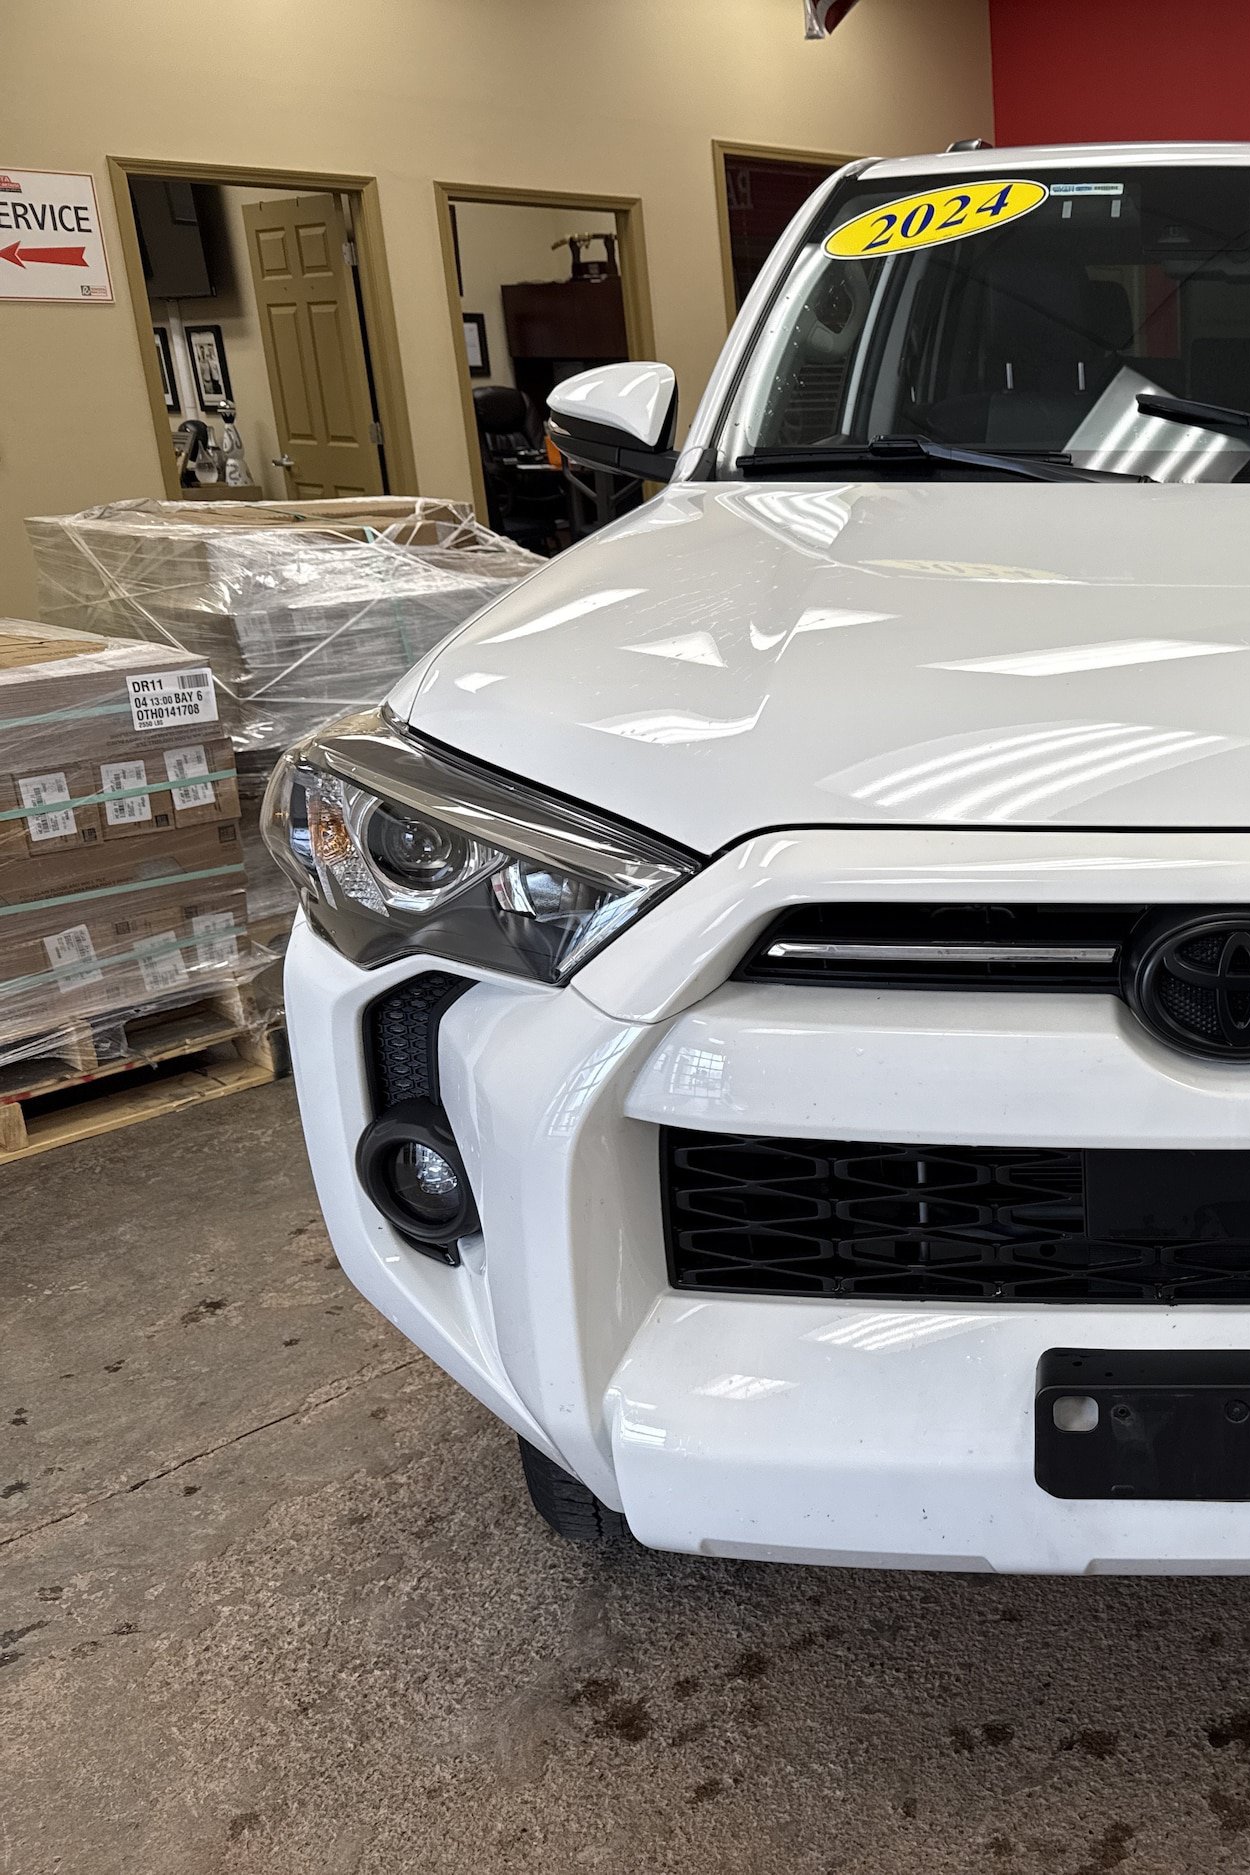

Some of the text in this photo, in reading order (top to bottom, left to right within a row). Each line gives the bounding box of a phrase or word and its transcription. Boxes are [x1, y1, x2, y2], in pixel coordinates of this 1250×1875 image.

[0, 201, 93, 233] ERVICE
[862, 184, 1014, 252] 2024
[131, 678, 163, 693] DR11
[134, 690, 203, 709] 04 13:00 BAY 6
